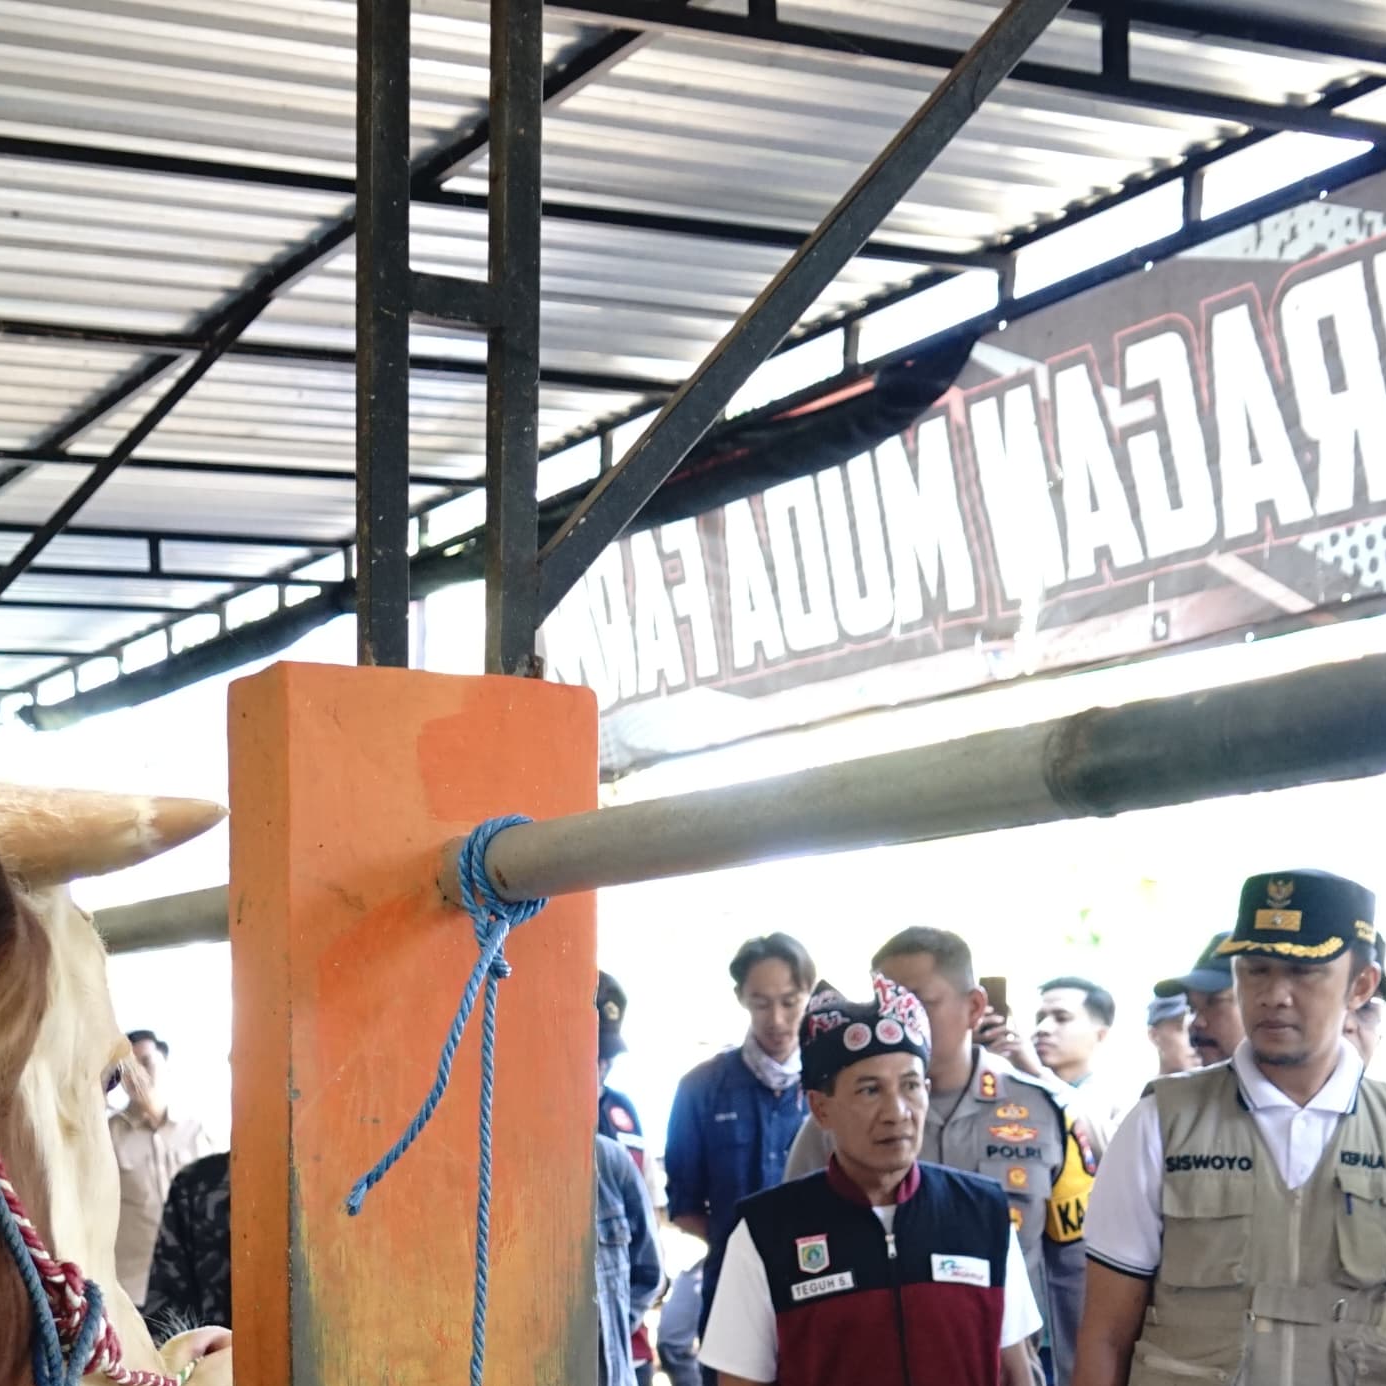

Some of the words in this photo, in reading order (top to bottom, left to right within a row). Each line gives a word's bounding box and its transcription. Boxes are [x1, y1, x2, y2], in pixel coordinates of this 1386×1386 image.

[986, 1145, 1043, 1160] POLRI
[1340, 1151, 1385, 1170] KEPALA
[1165, 1154, 1254, 1173] SISWOYO
[795, 1279, 835, 1298] TEGUH
